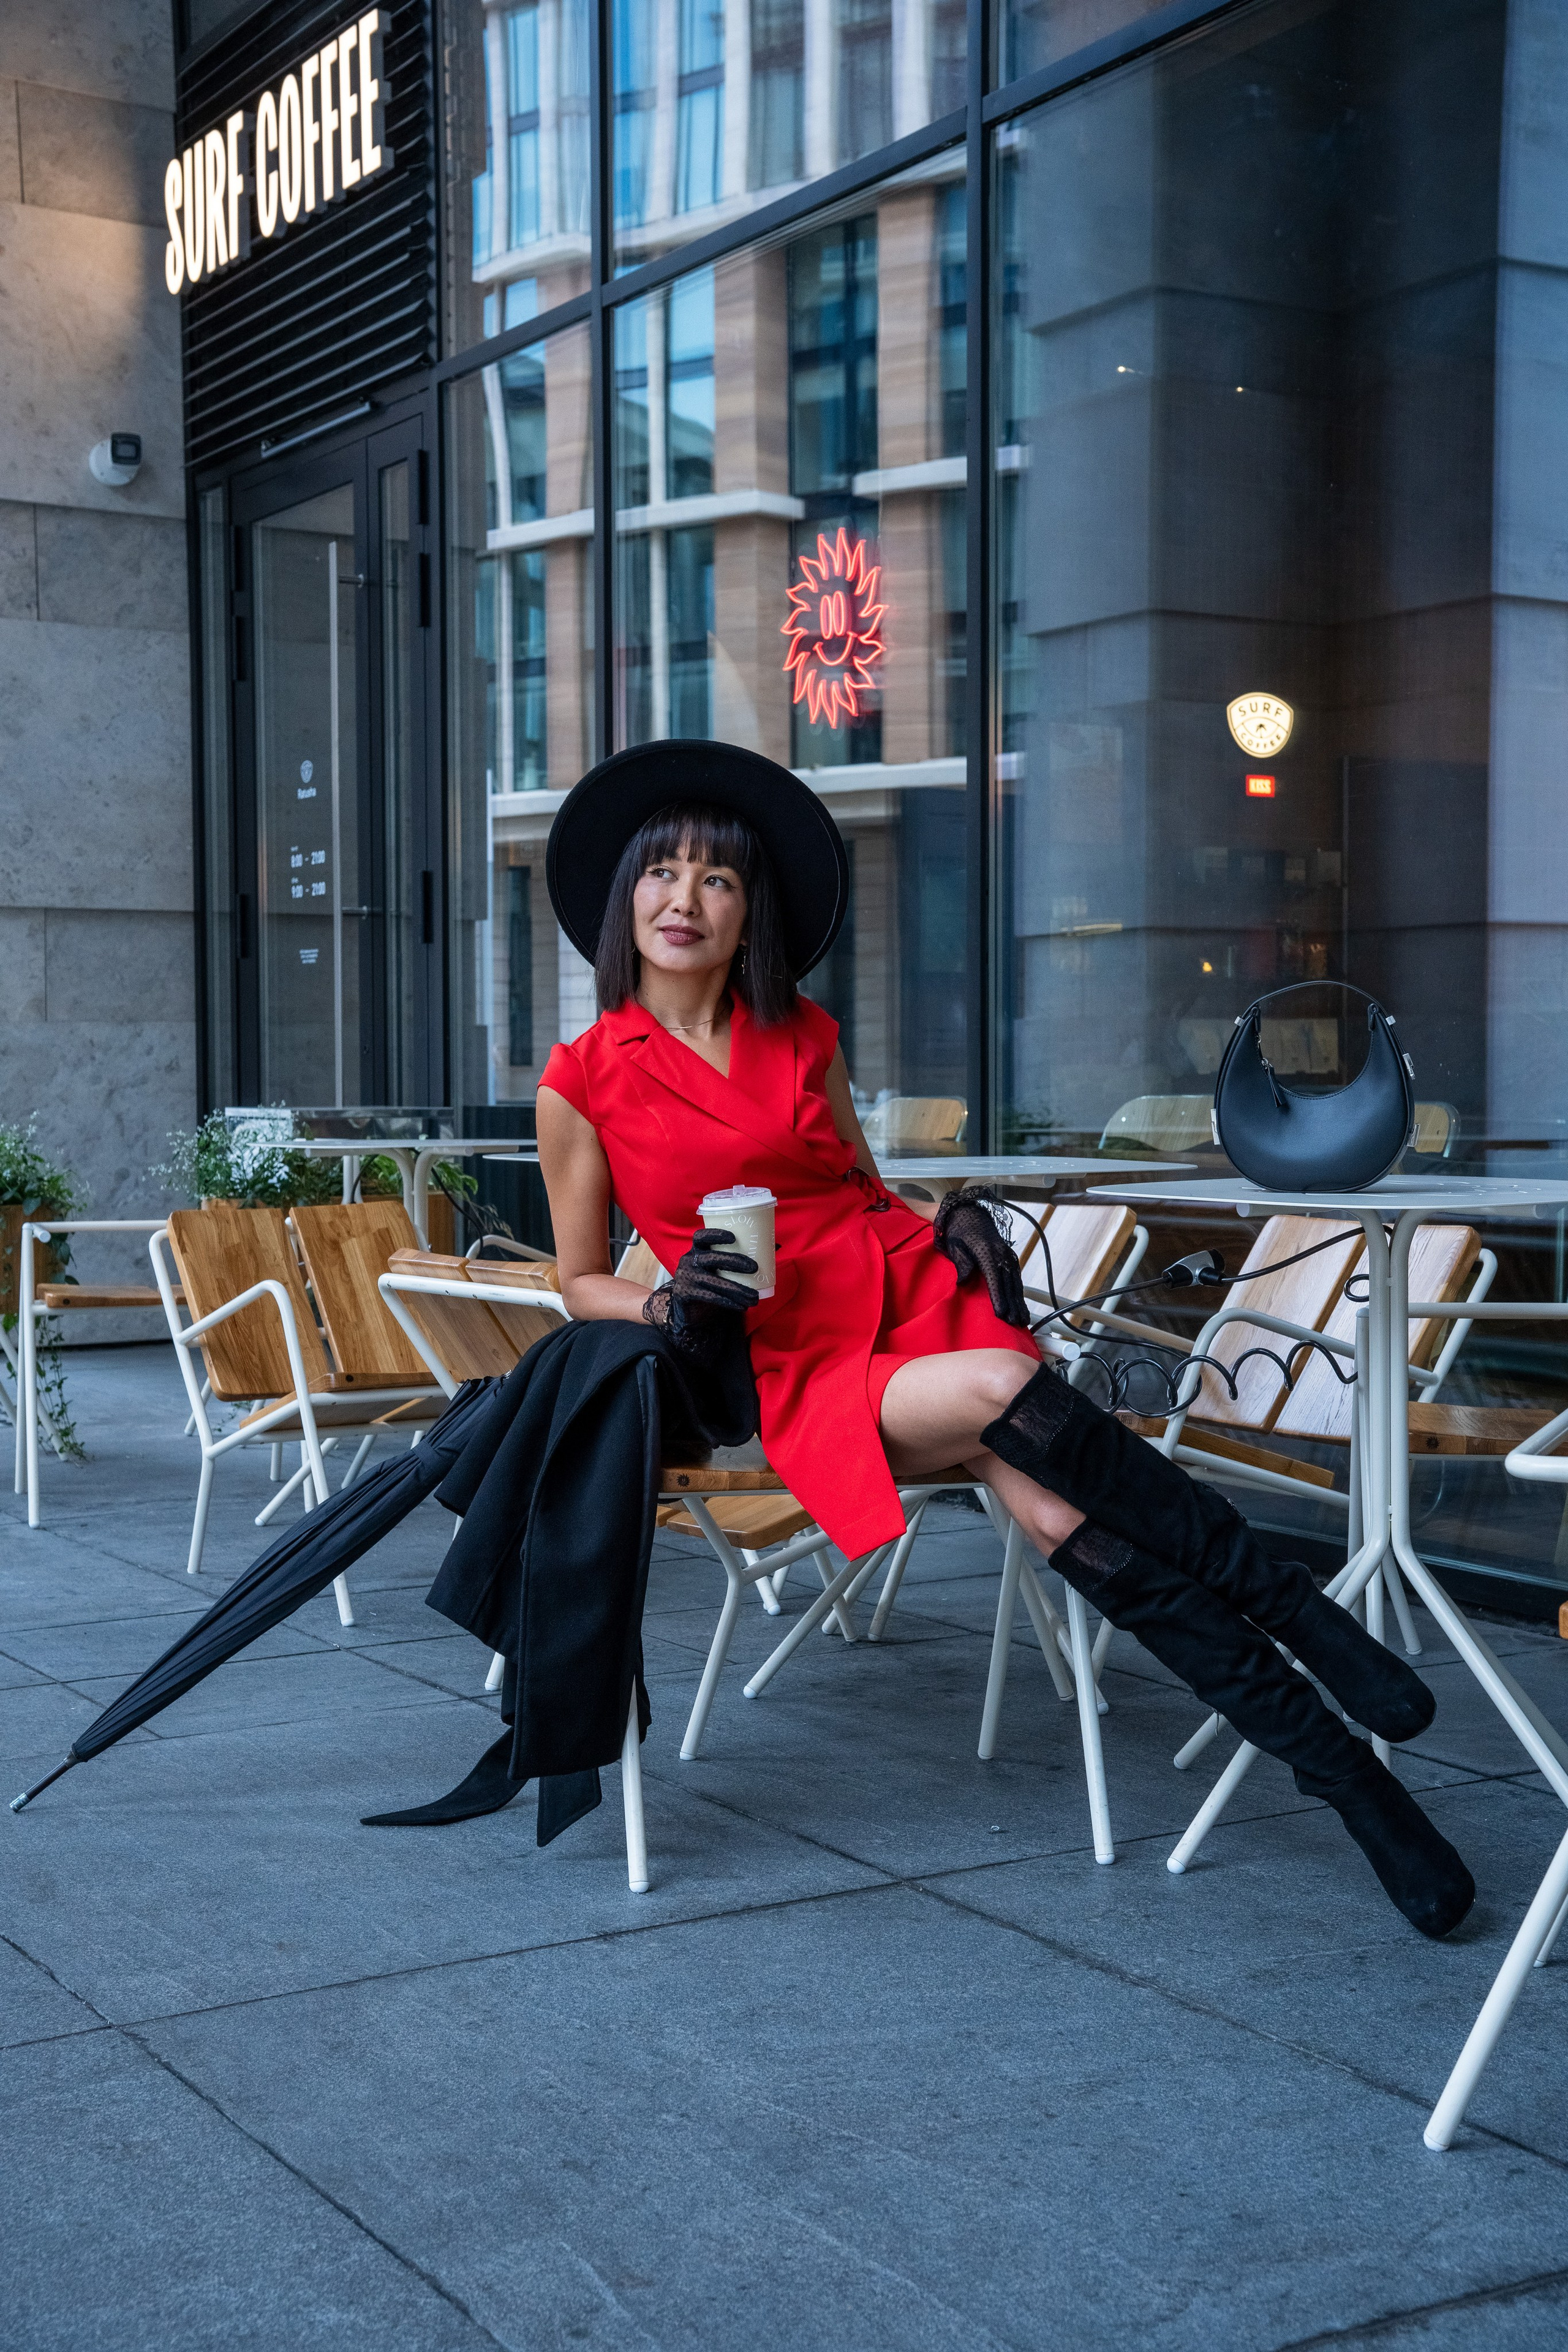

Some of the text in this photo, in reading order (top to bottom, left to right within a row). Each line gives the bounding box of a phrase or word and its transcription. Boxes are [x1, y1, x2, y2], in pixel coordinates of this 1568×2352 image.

[165, 8, 382, 295] SURF COFFEE
[1238, 702, 1283, 717] SURF
[1241, 733, 1281, 749] COFFEE
[1248, 778, 1272, 794] KISS
[292, 885, 304, 899] 9:00
[725, 1215, 756, 1229] SLOW
